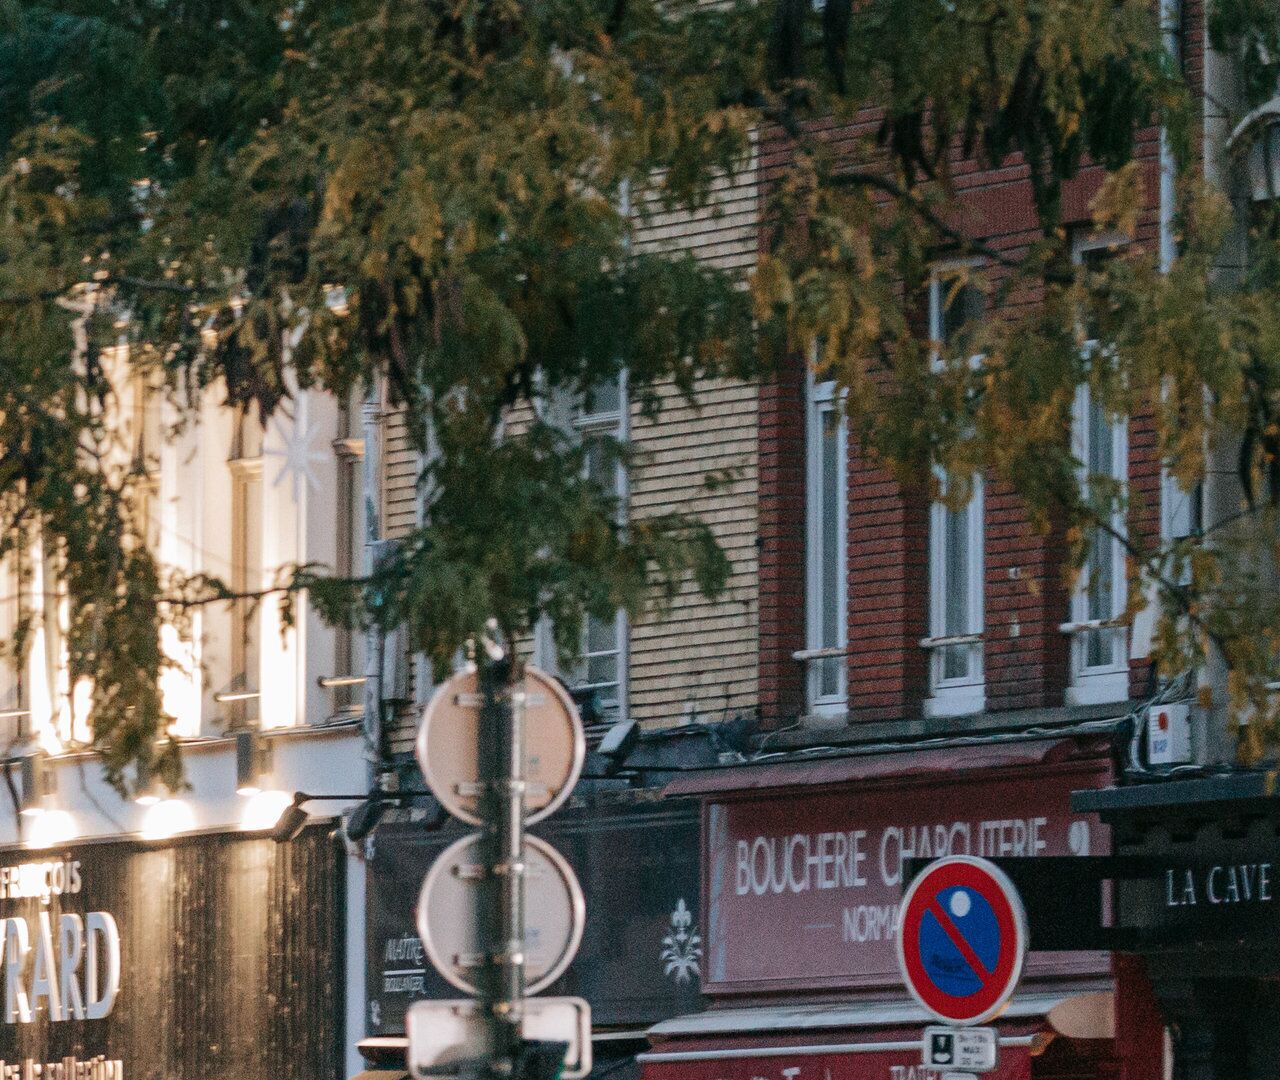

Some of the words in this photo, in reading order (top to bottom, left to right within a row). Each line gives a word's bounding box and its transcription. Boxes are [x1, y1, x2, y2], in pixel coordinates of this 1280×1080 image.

[736, 829, 867, 895] BOUCHERIE
[1166, 868, 1197, 906] LA
[1206, 863, 1272, 904] CAVE
